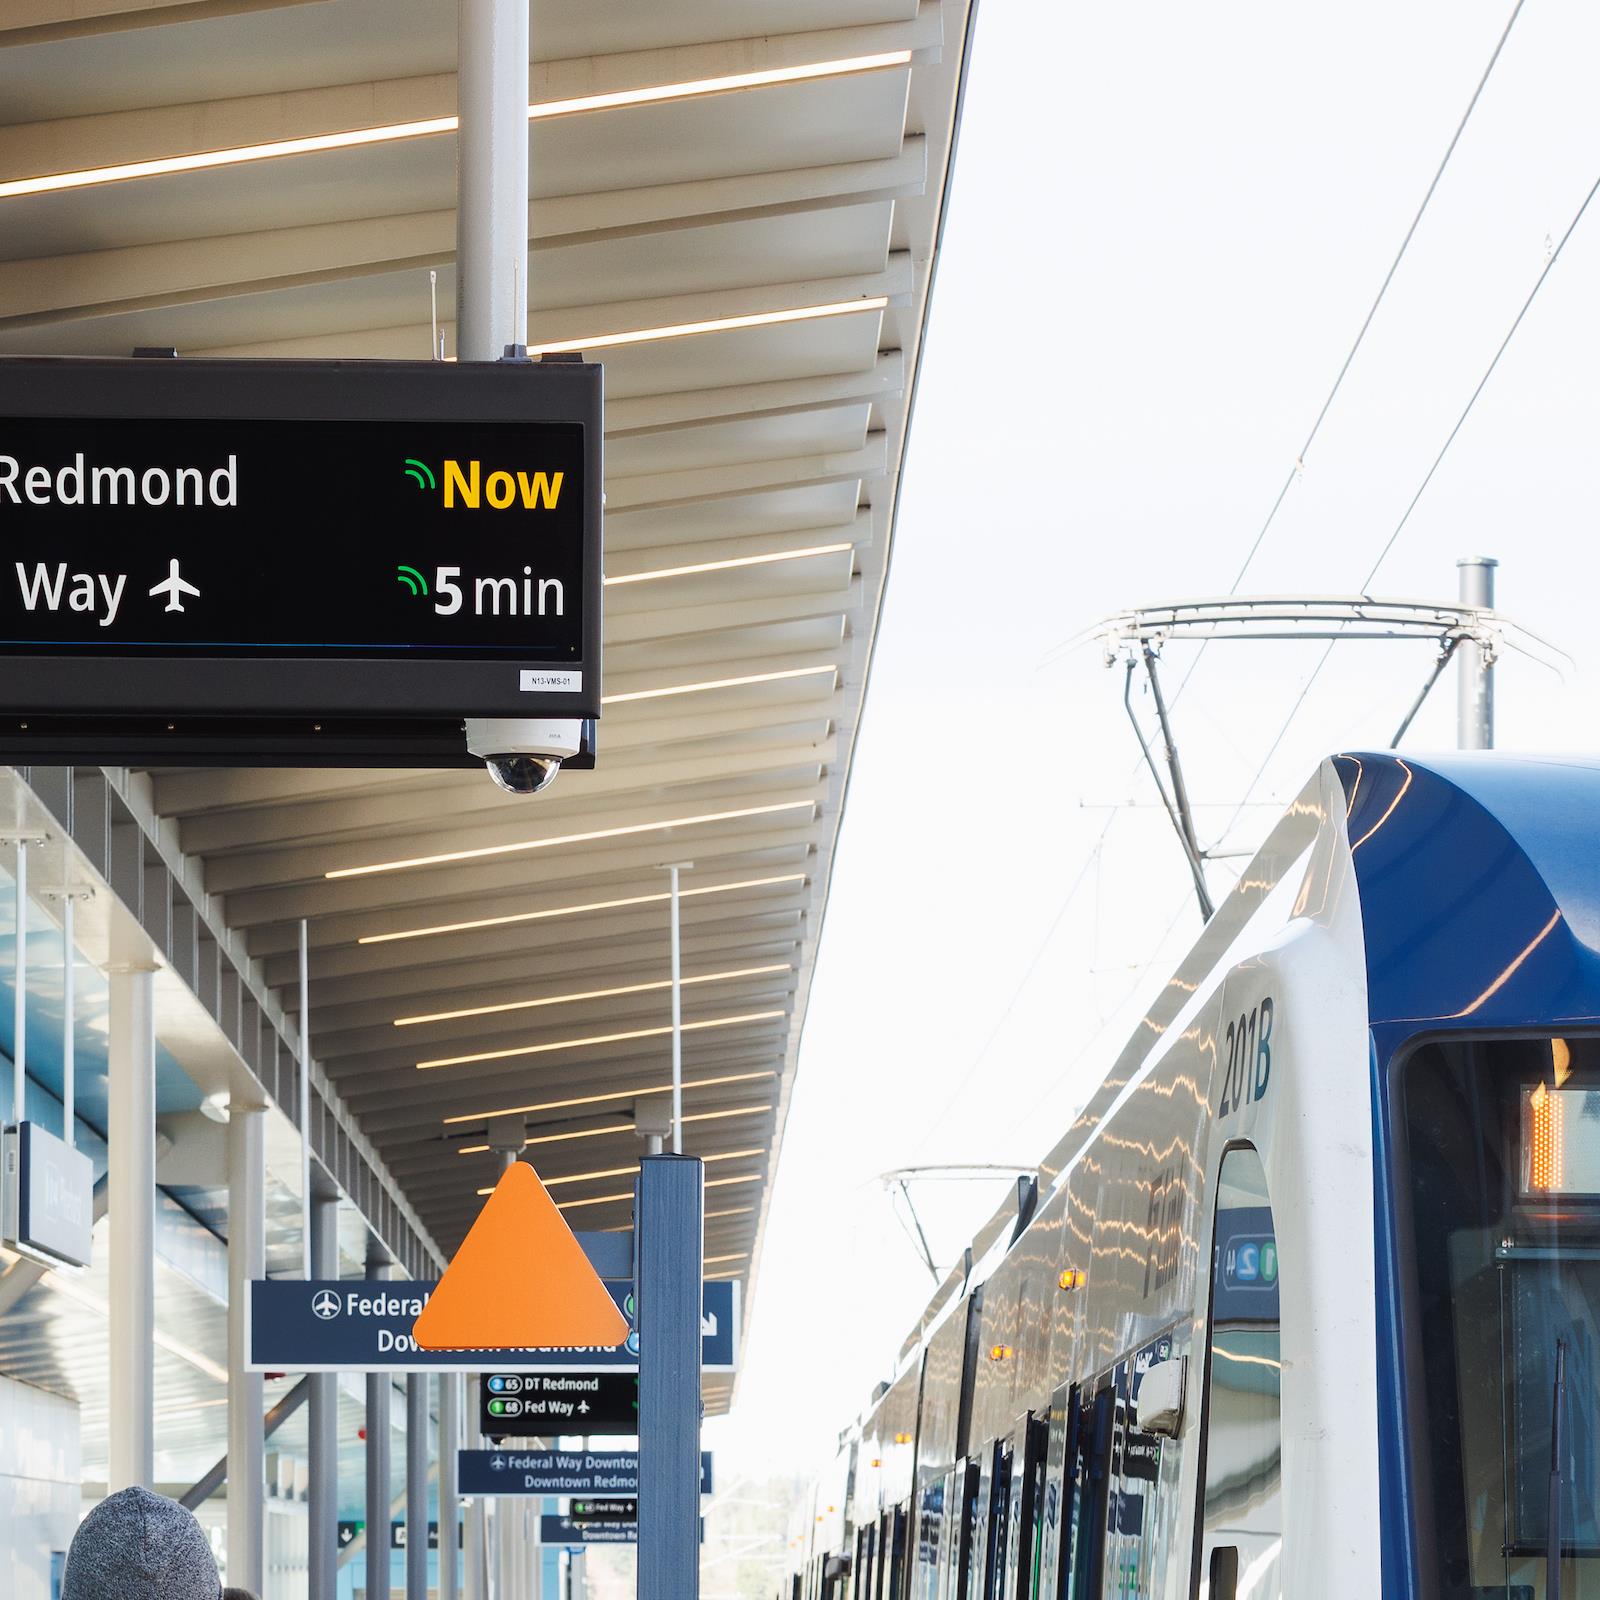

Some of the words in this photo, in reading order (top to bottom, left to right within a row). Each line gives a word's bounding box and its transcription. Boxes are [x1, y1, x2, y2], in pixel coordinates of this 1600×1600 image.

[443, 459, 565, 510] Now
[15, 561, 127, 627] Way
[434, 566, 463, 616] 5
[475, 565, 564, 616] min
[1219, 996, 1274, 1120] 201B
[505, 1378, 518, 1390] 65
[524, 1377, 541, 1391] DT
[542, 1377, 599, 1391] Redmond
[505, 1401, 518, 1413] 68
[524, 1400, 546, 1414] Fed
[548, 1400, 575, 1417] Way
[508, 1455, 553, 1470] Federal
[556, 1456, 582, 1472] Way
[585, 1455, 638, 1470] Downtow
[524, 1475, 590, 1489] Downtown
[593, 1475, 638, 1489] Redmo
